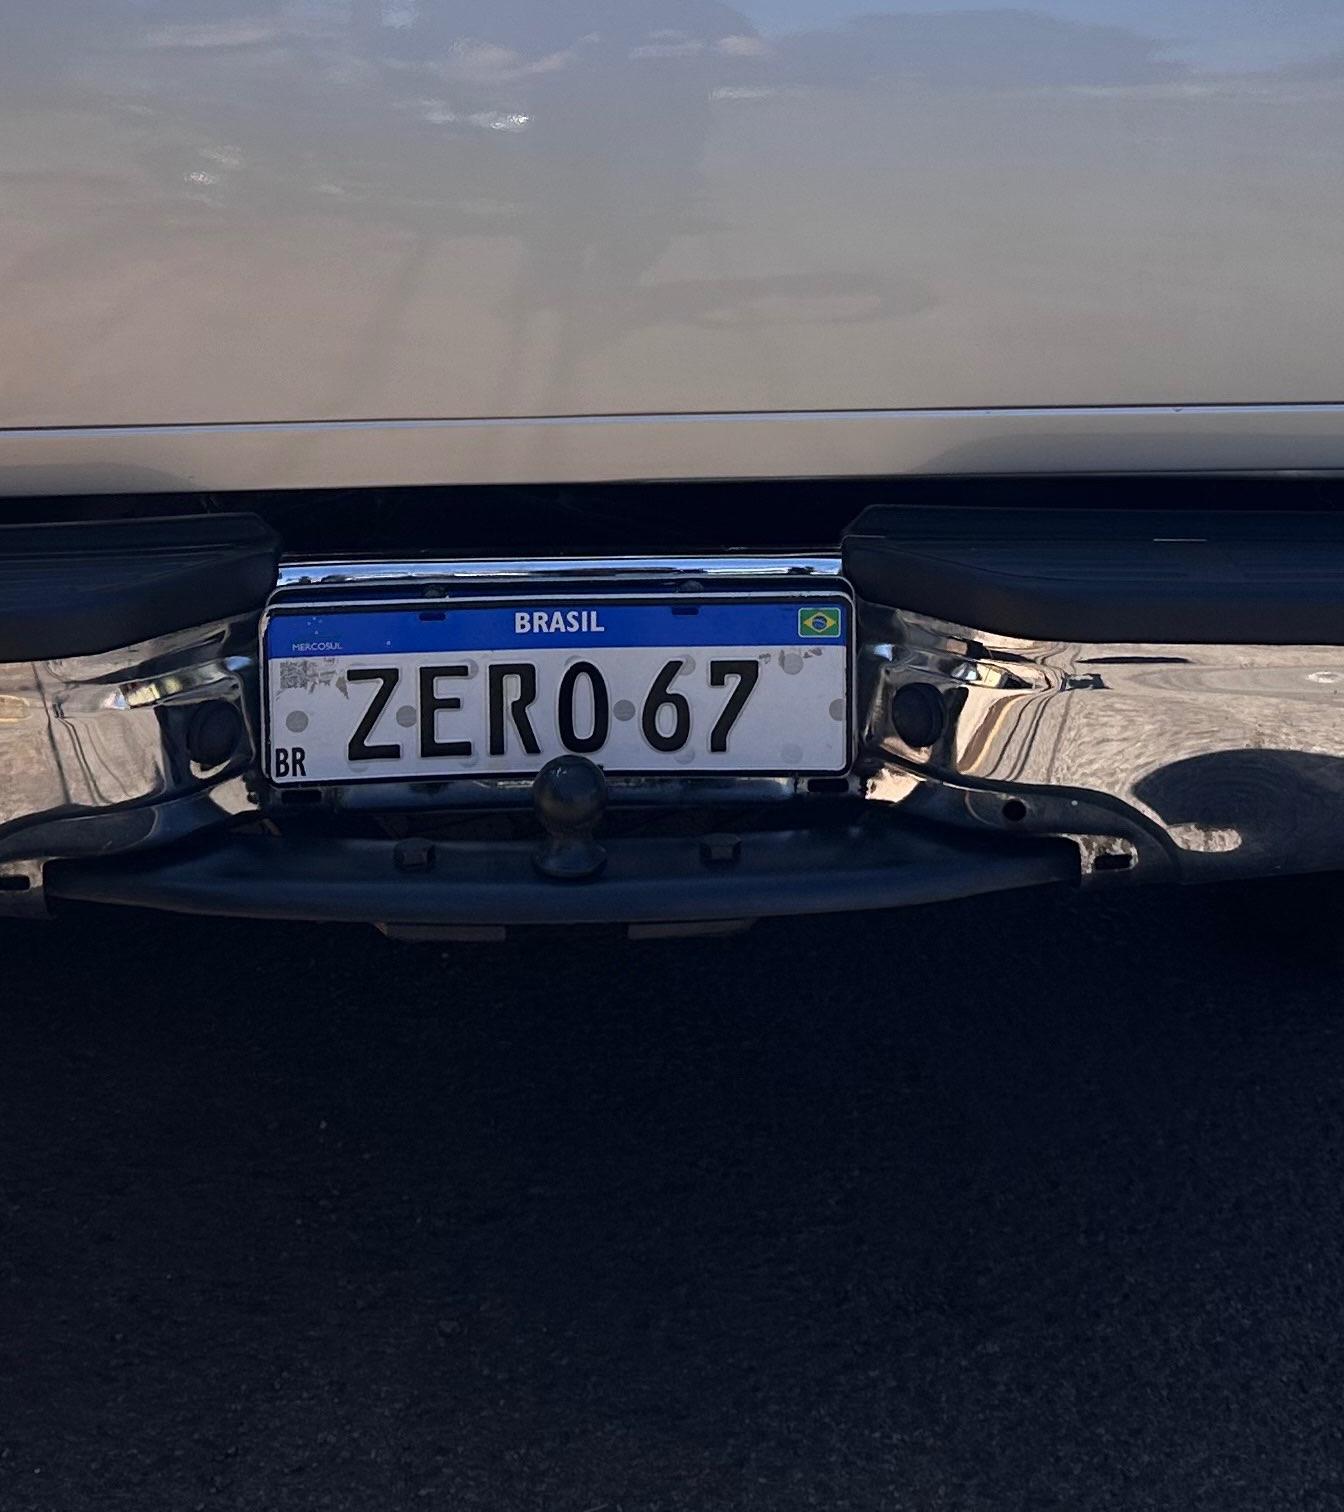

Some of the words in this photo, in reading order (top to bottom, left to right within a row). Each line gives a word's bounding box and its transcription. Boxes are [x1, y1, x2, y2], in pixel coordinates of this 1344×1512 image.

[515, 610, 605, 634] BRASIL
[292, 641, 343, 651] MERCOSUL
[275, 747, 307, 778] BR
